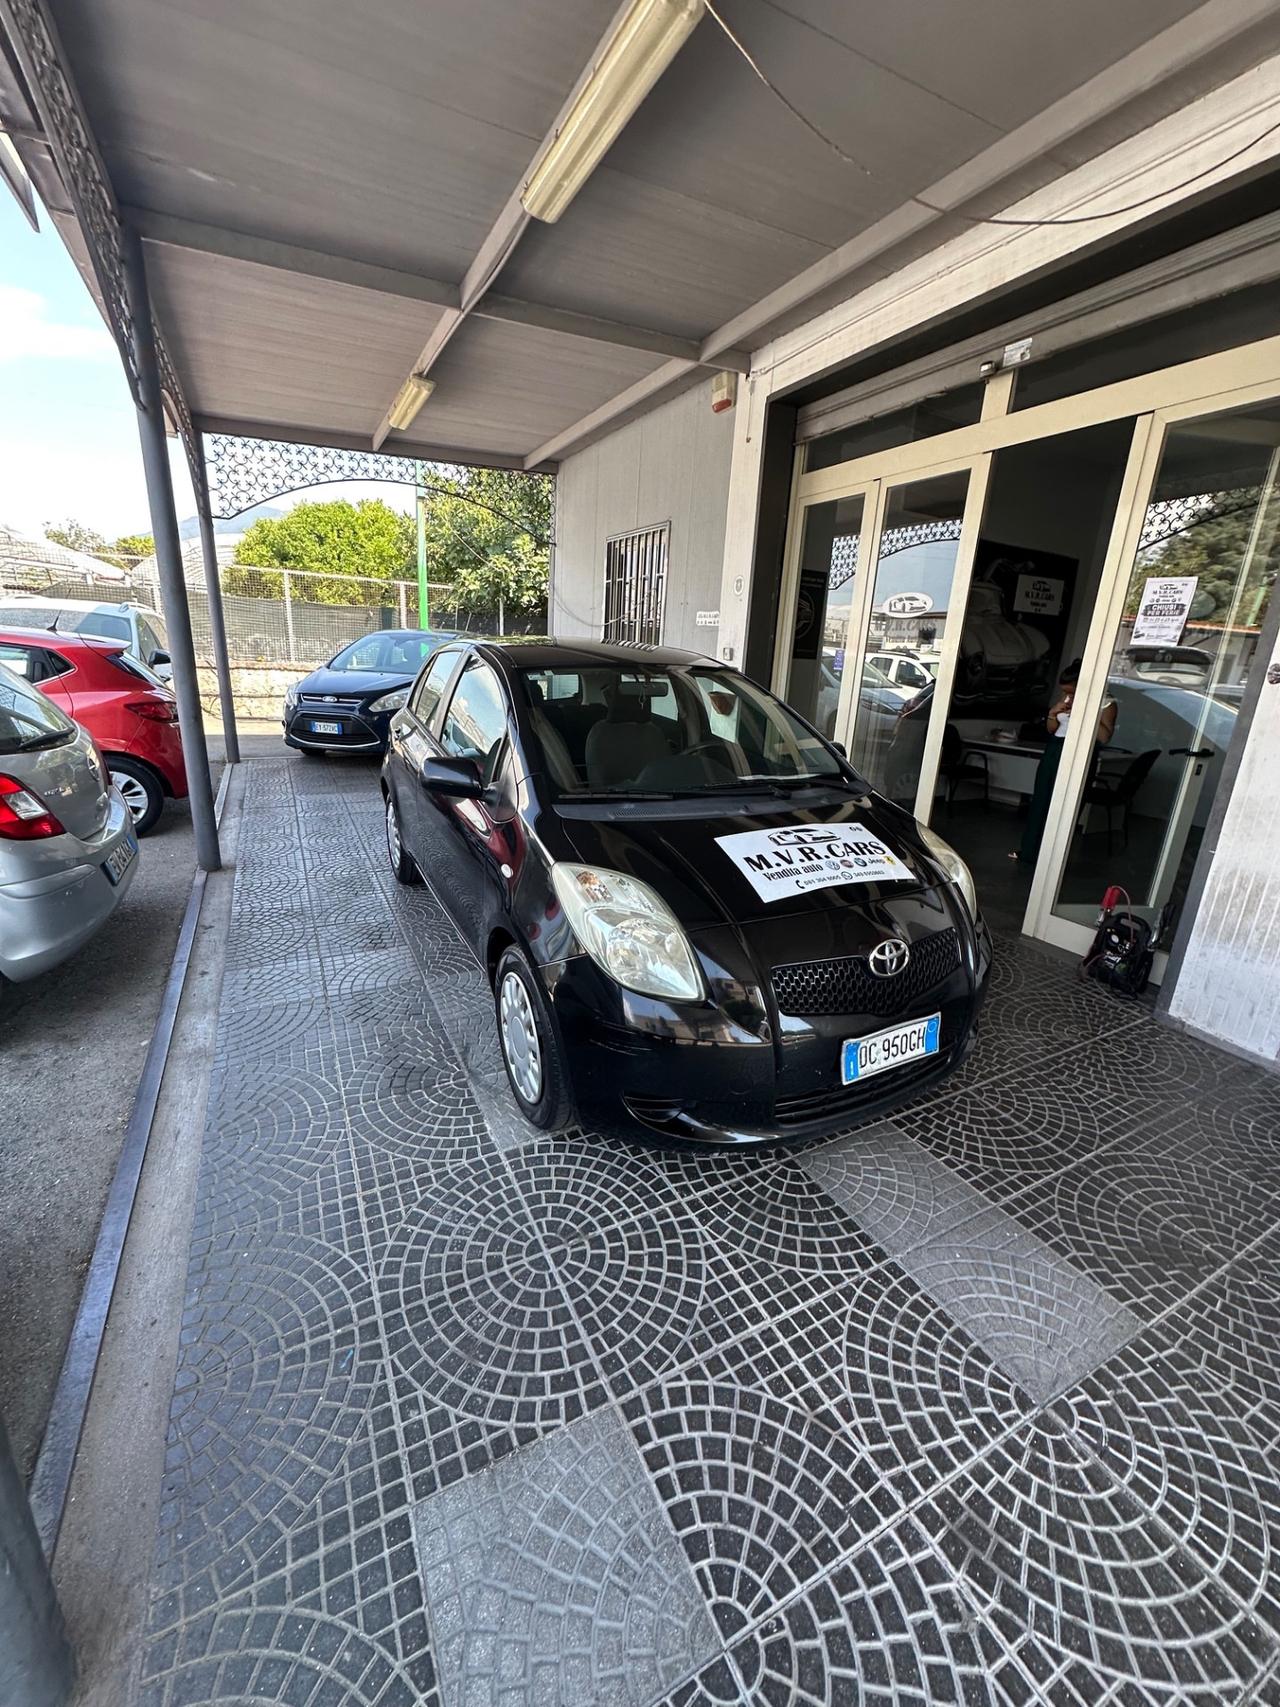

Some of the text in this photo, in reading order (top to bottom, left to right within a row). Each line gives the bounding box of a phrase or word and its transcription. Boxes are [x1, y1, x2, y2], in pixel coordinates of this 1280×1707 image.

[1151, 603, 1177, 611] CHIUSI
[763, 863, 824, 881] Vendita auto
[882, 1026, 926, 1060] 950GH
